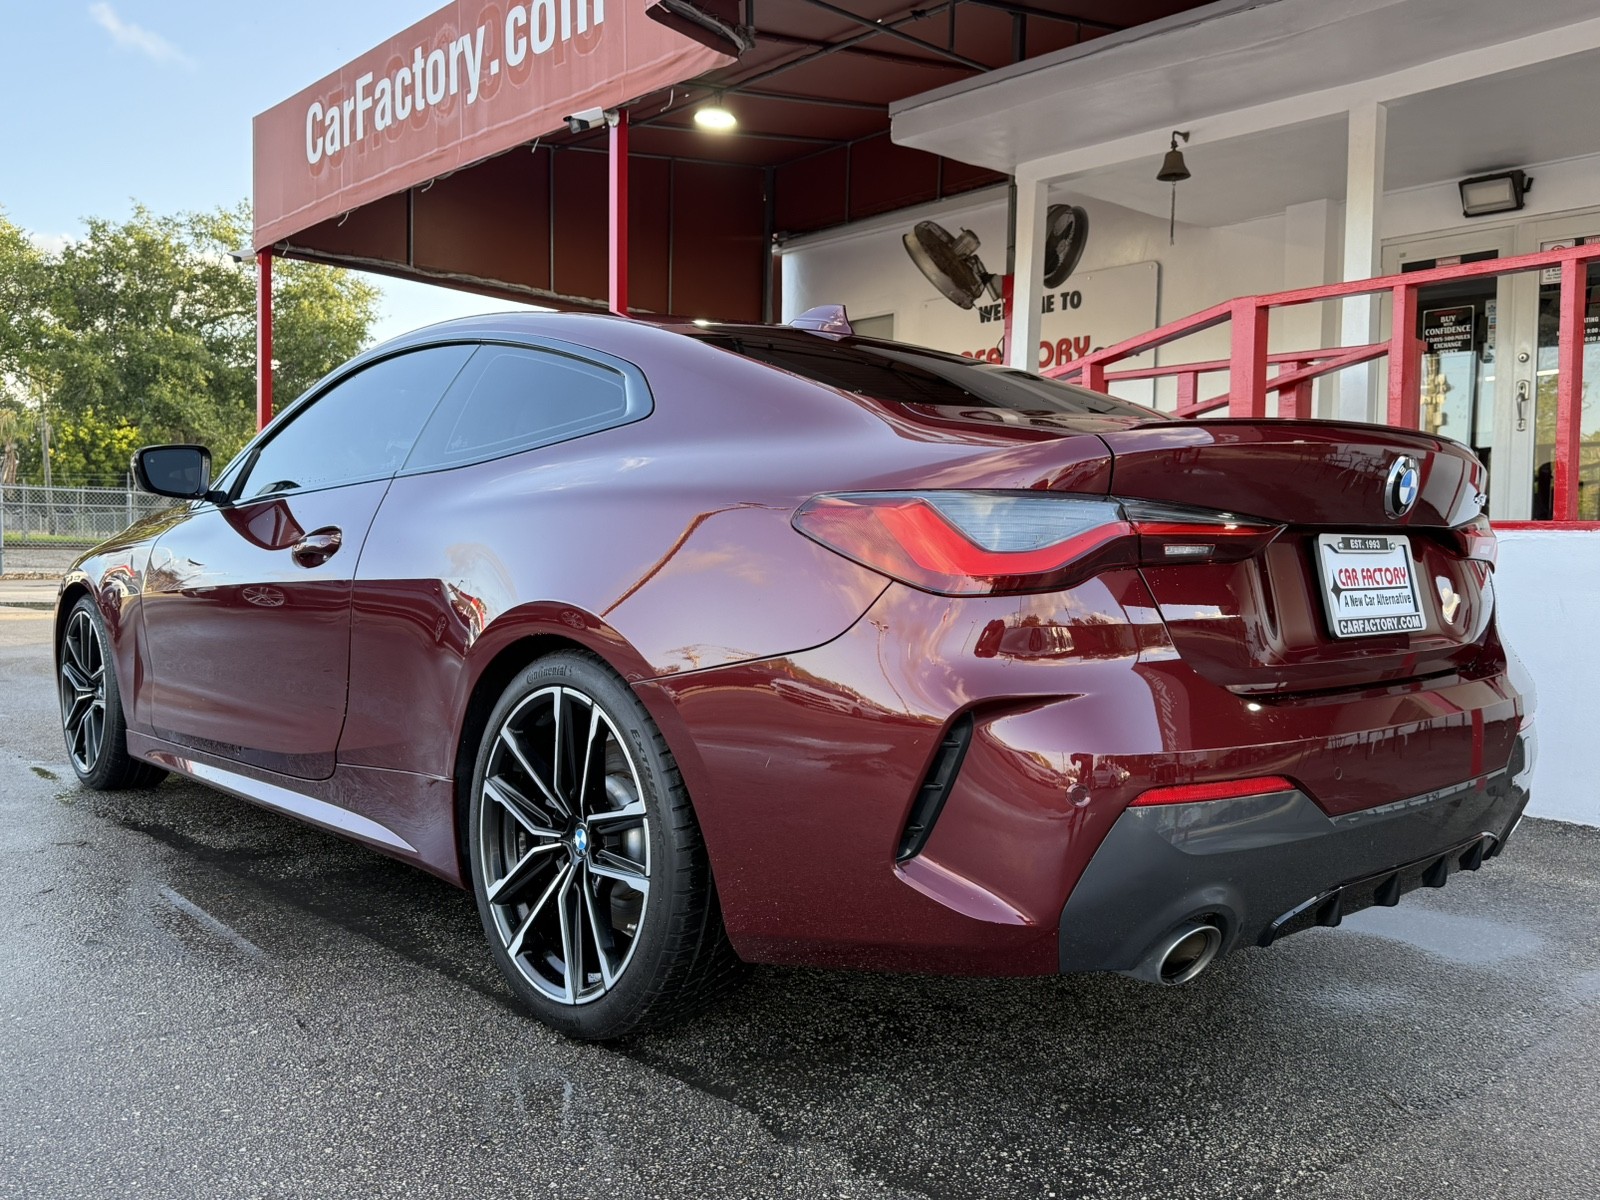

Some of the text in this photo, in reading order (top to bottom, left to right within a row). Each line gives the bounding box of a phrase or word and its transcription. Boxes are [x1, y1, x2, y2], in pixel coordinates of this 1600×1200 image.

[1060, 290, 1082, 311] TO
[1440, 315, 1456, 323] BUY
[1425, 325, 1471, 336] CONFIDENCE
[1433, 341, 1462, 349] EXCHANGE
[1350, 539, 1380, 549] EST. 1993
[1338, 566, 1406, 587] CAR FACTORY
[1344, 593, 1411, 608] A New Car Alternative
[1340, 616, 1420, 634] CARFACTORY.COM
[526, 664, 567, 684] Continental
